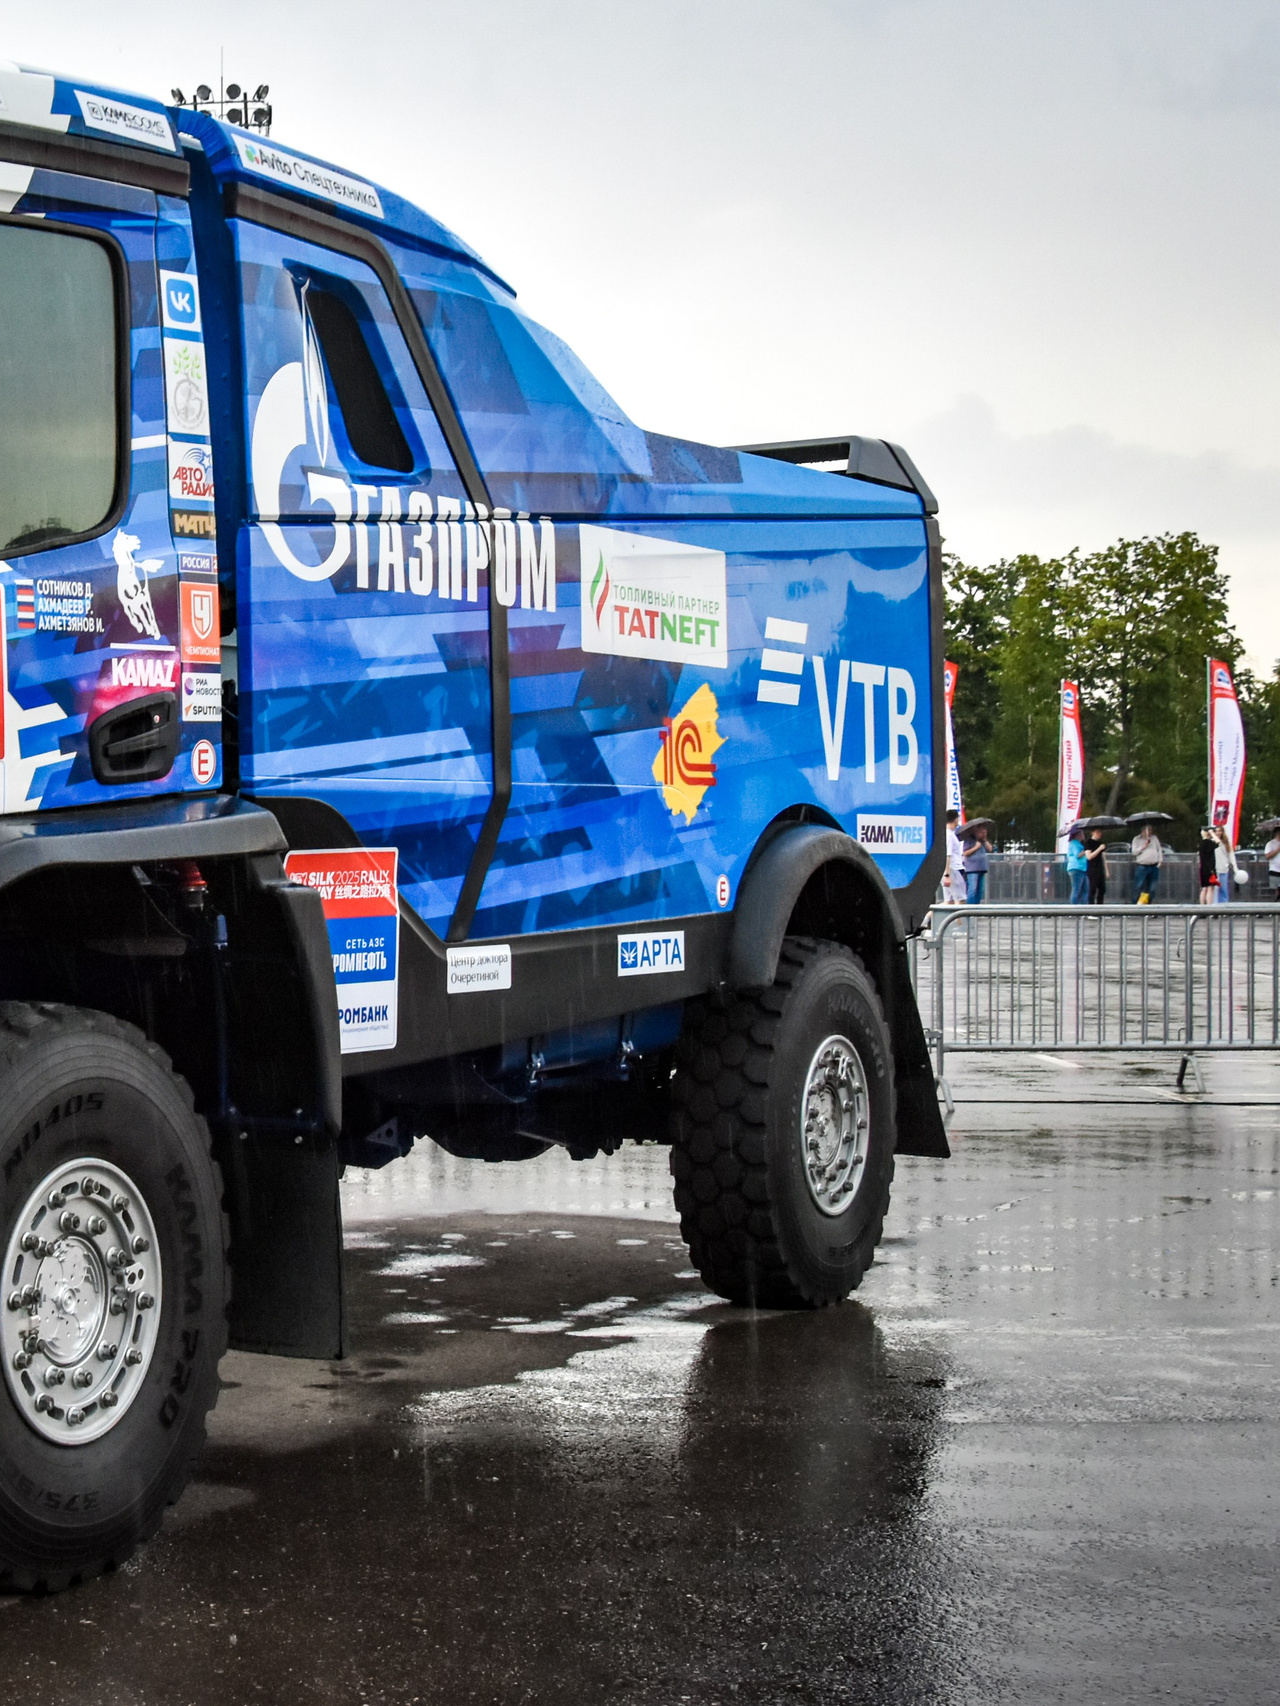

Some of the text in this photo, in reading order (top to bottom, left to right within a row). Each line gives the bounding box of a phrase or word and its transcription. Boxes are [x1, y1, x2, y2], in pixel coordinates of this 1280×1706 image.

[258, 148, 378, 208] Avito Спецтехника
[170, 290, 192, 313] VK
[173, 466, 203, 482] АВТО
[353, 483, 556, 612] ГАЗПРОМ
[182, 556, 210, 570] РОССИЯ
[37, 579, 94, 599] СОТНИКОВ Д.
[38, 597, 94, 616] АХМАДЕЕВ Р.
[614, 584, 720, 615] ТОПЛИВНЫЙ ПАРТНЕР
[39, 615, 105, 633] АХМЕТЗЯНОВ И.
[614, 605, 720, 648] TATNEFT
[111, 658, 176, 688] KAMAZ
[196, 678, 208, 686] РИА
[812, 655, 919, 785] VTB
[198, 749, 209, 775] E
[861, 825, 923, 844] KAMA TYRES
[308, 870, 390, 886] SILK 2025 RALLY
[346, 937, 385, 949] СЕТЬ АЗС
[451, 954, 508, 968] Центр доктора
[451, 970, 499, 985] Очеретиной
